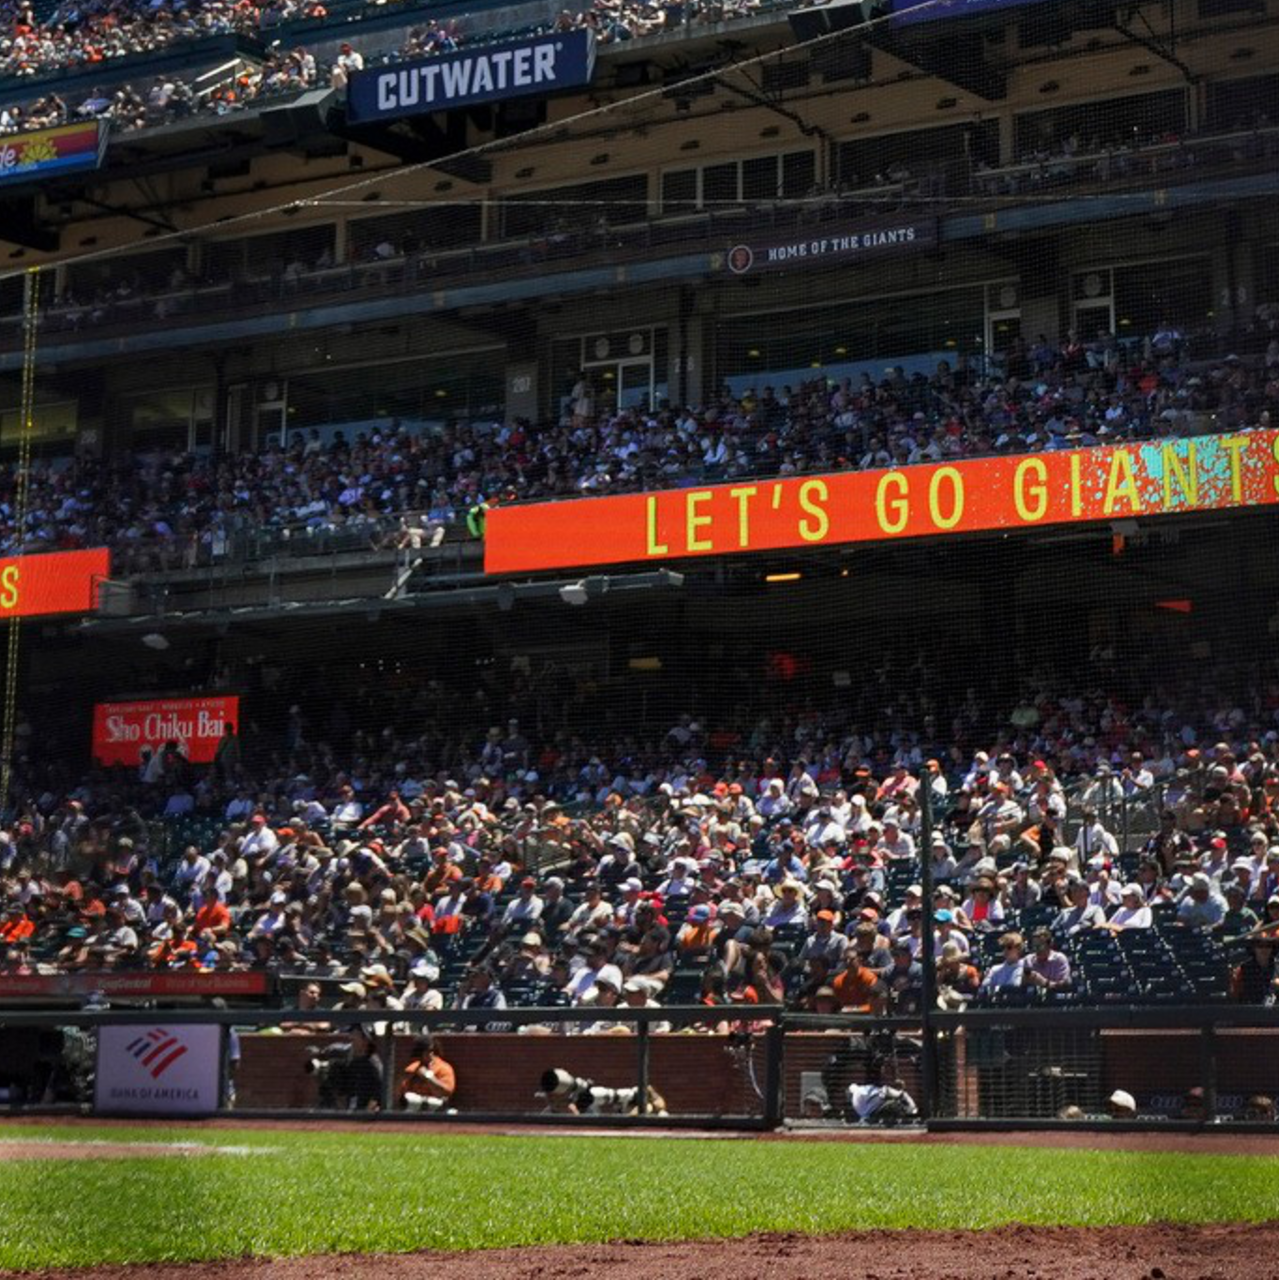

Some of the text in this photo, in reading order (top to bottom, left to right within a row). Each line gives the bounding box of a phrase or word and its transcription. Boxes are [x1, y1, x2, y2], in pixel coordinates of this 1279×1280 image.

[768, 227, 915, 261] HOME OF THE GIANTS
[1221, 287, 1247, 306] 29
[645, 478, 830, 556] LET'S
[874, 466, 965, 535] GO
[105, 710, 226, 744] Sho Chiku Bai
[110, 1088, 199, 1099] BANK OF AMERICA
